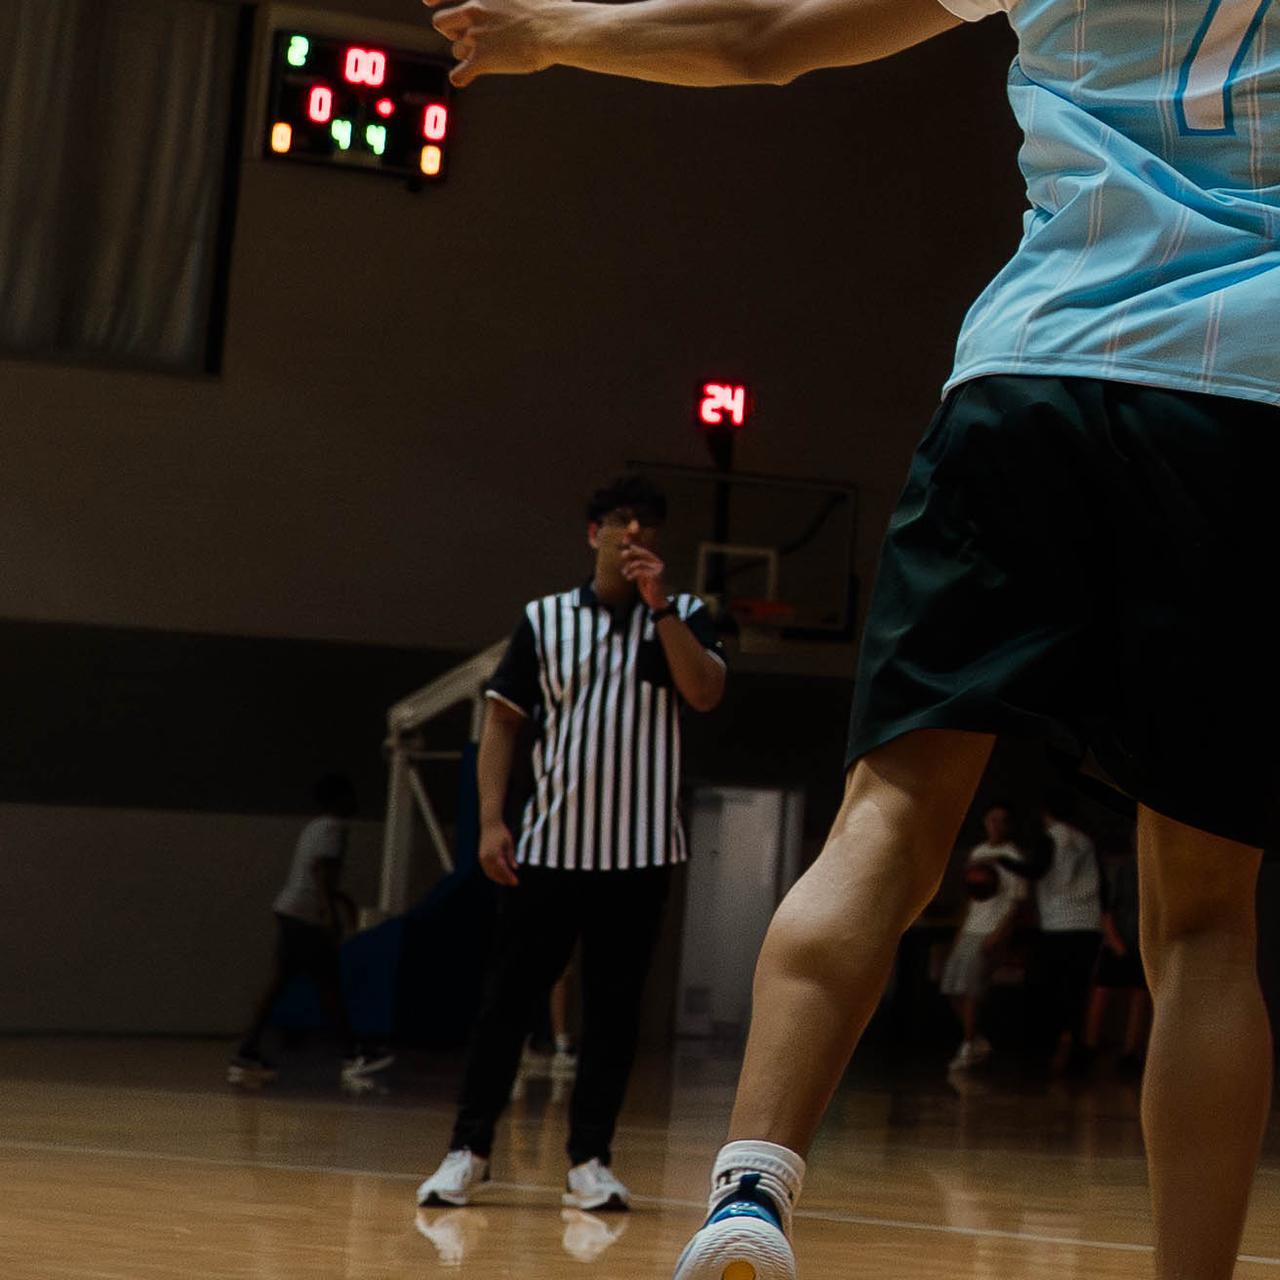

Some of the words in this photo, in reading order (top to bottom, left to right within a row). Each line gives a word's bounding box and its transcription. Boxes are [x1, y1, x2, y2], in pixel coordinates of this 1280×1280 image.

[309, 87, 333, 122] 0
[424, 104, 448, 140] 0
[702, 384, 744, 425] 24
